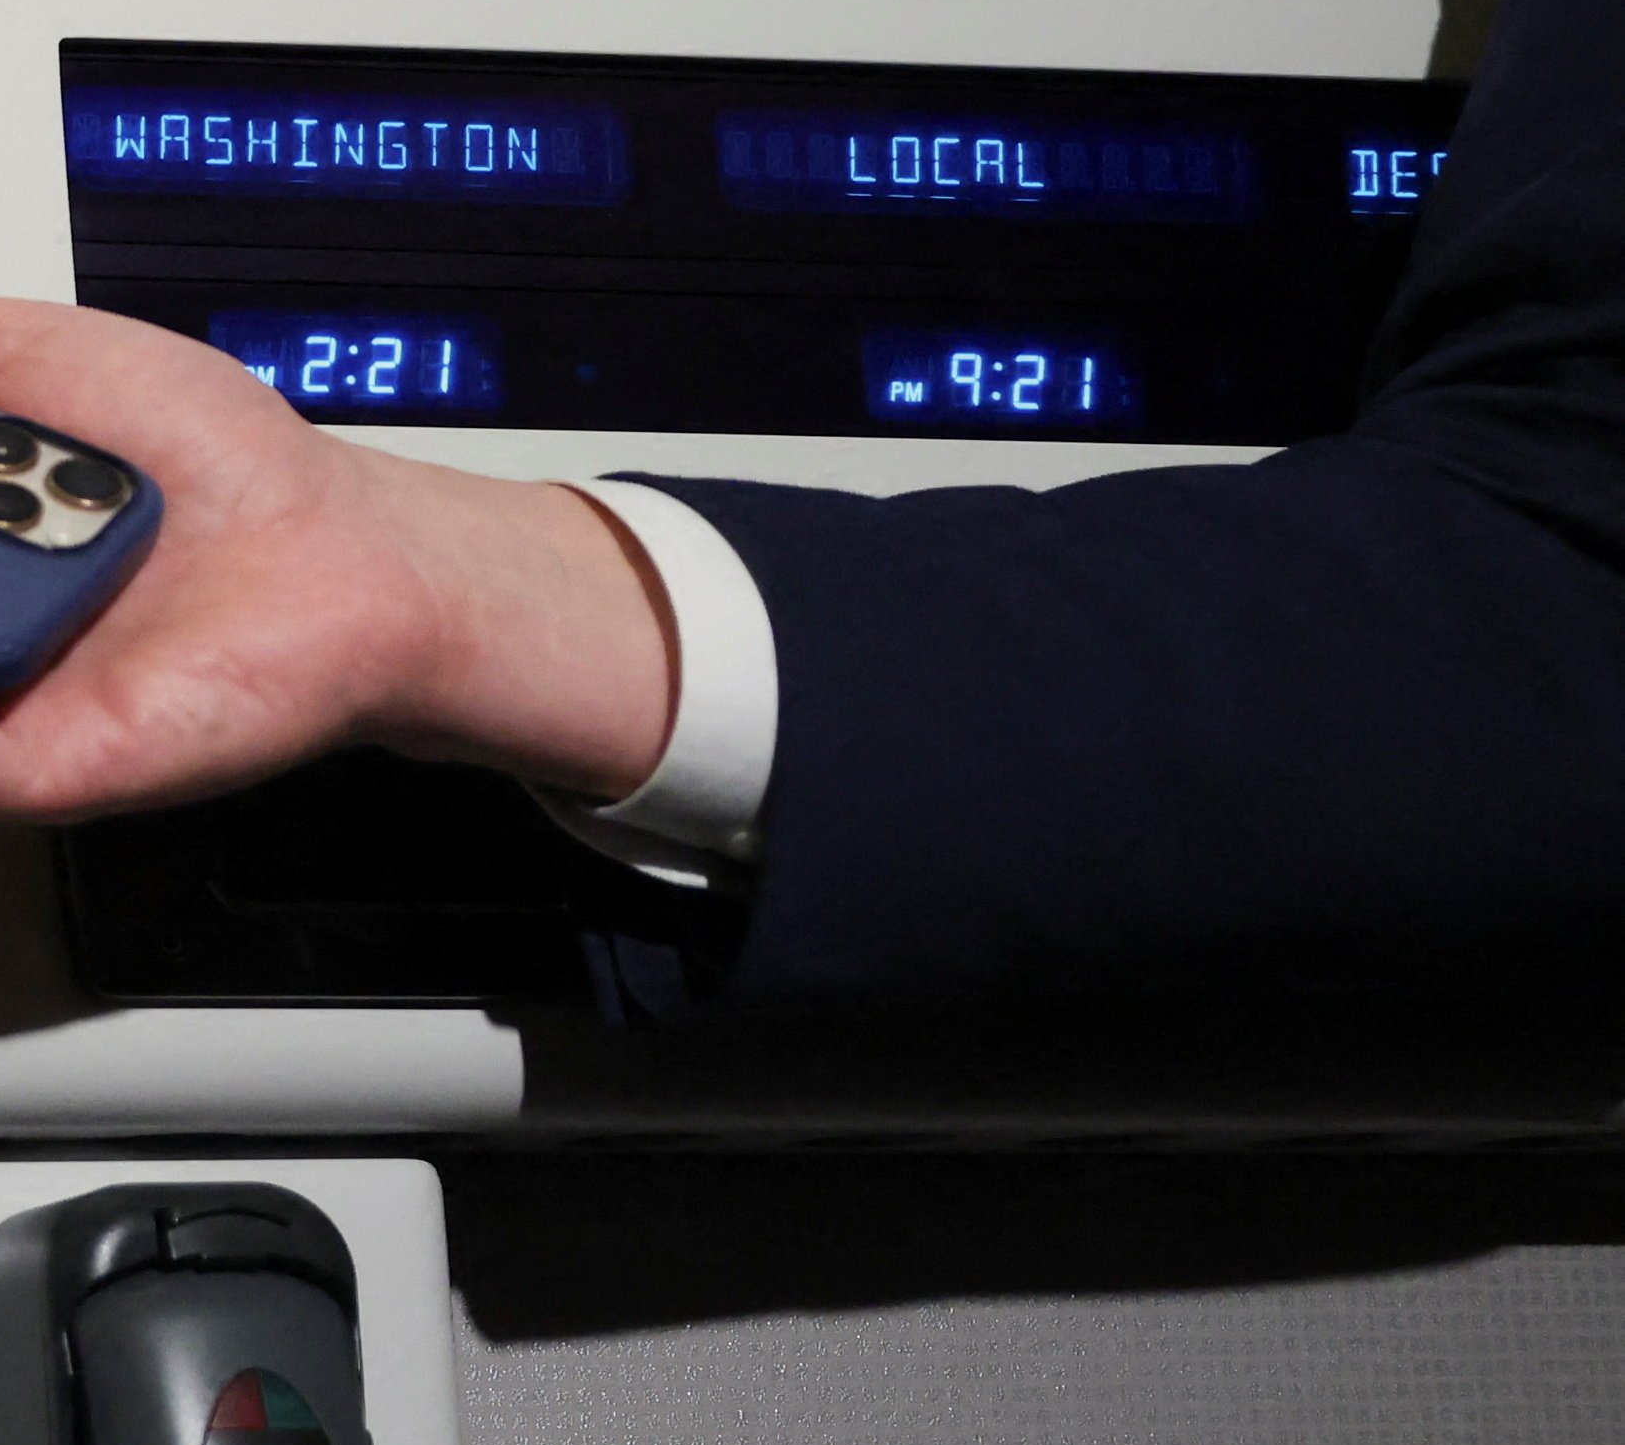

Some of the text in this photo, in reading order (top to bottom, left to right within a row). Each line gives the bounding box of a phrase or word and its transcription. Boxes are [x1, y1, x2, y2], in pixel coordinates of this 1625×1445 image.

[115, 114, 538, 172] WASHINGTON
[849, 136, 1045, 188] LOCAL
[301, 335, 452, 394] 2:21
[890, 352, 1094, 410] PM 9:21
